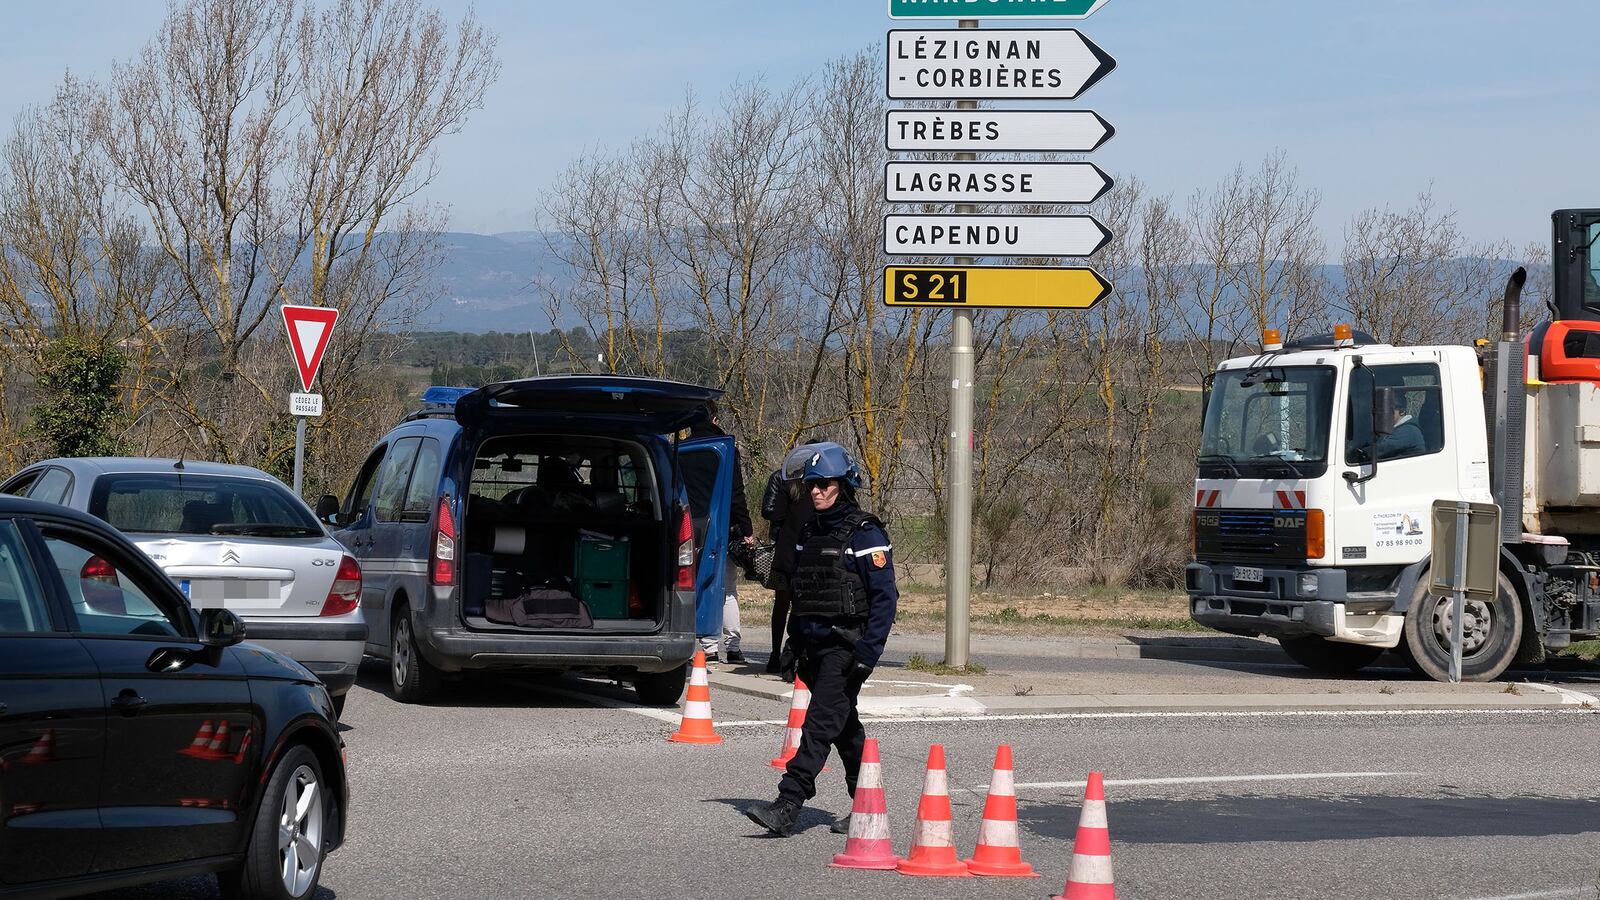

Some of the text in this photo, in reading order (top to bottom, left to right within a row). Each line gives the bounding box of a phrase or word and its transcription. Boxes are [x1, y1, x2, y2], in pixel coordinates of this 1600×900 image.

[898, 36, 1041, 60] LÉZIGNAN
[916, 64, 1062, 88] CORBIÈRES
[897, 117, 1000, 141] TRÈBES
[895, 173, 1033, 193] LAGRASSE
[895, 225, 1019, 245] CAPENDU
[902, 274, 960, 299] S 21
[295, 404, 317, 412] PASSAGE
[1274, 517, 1305, 528] DAF
